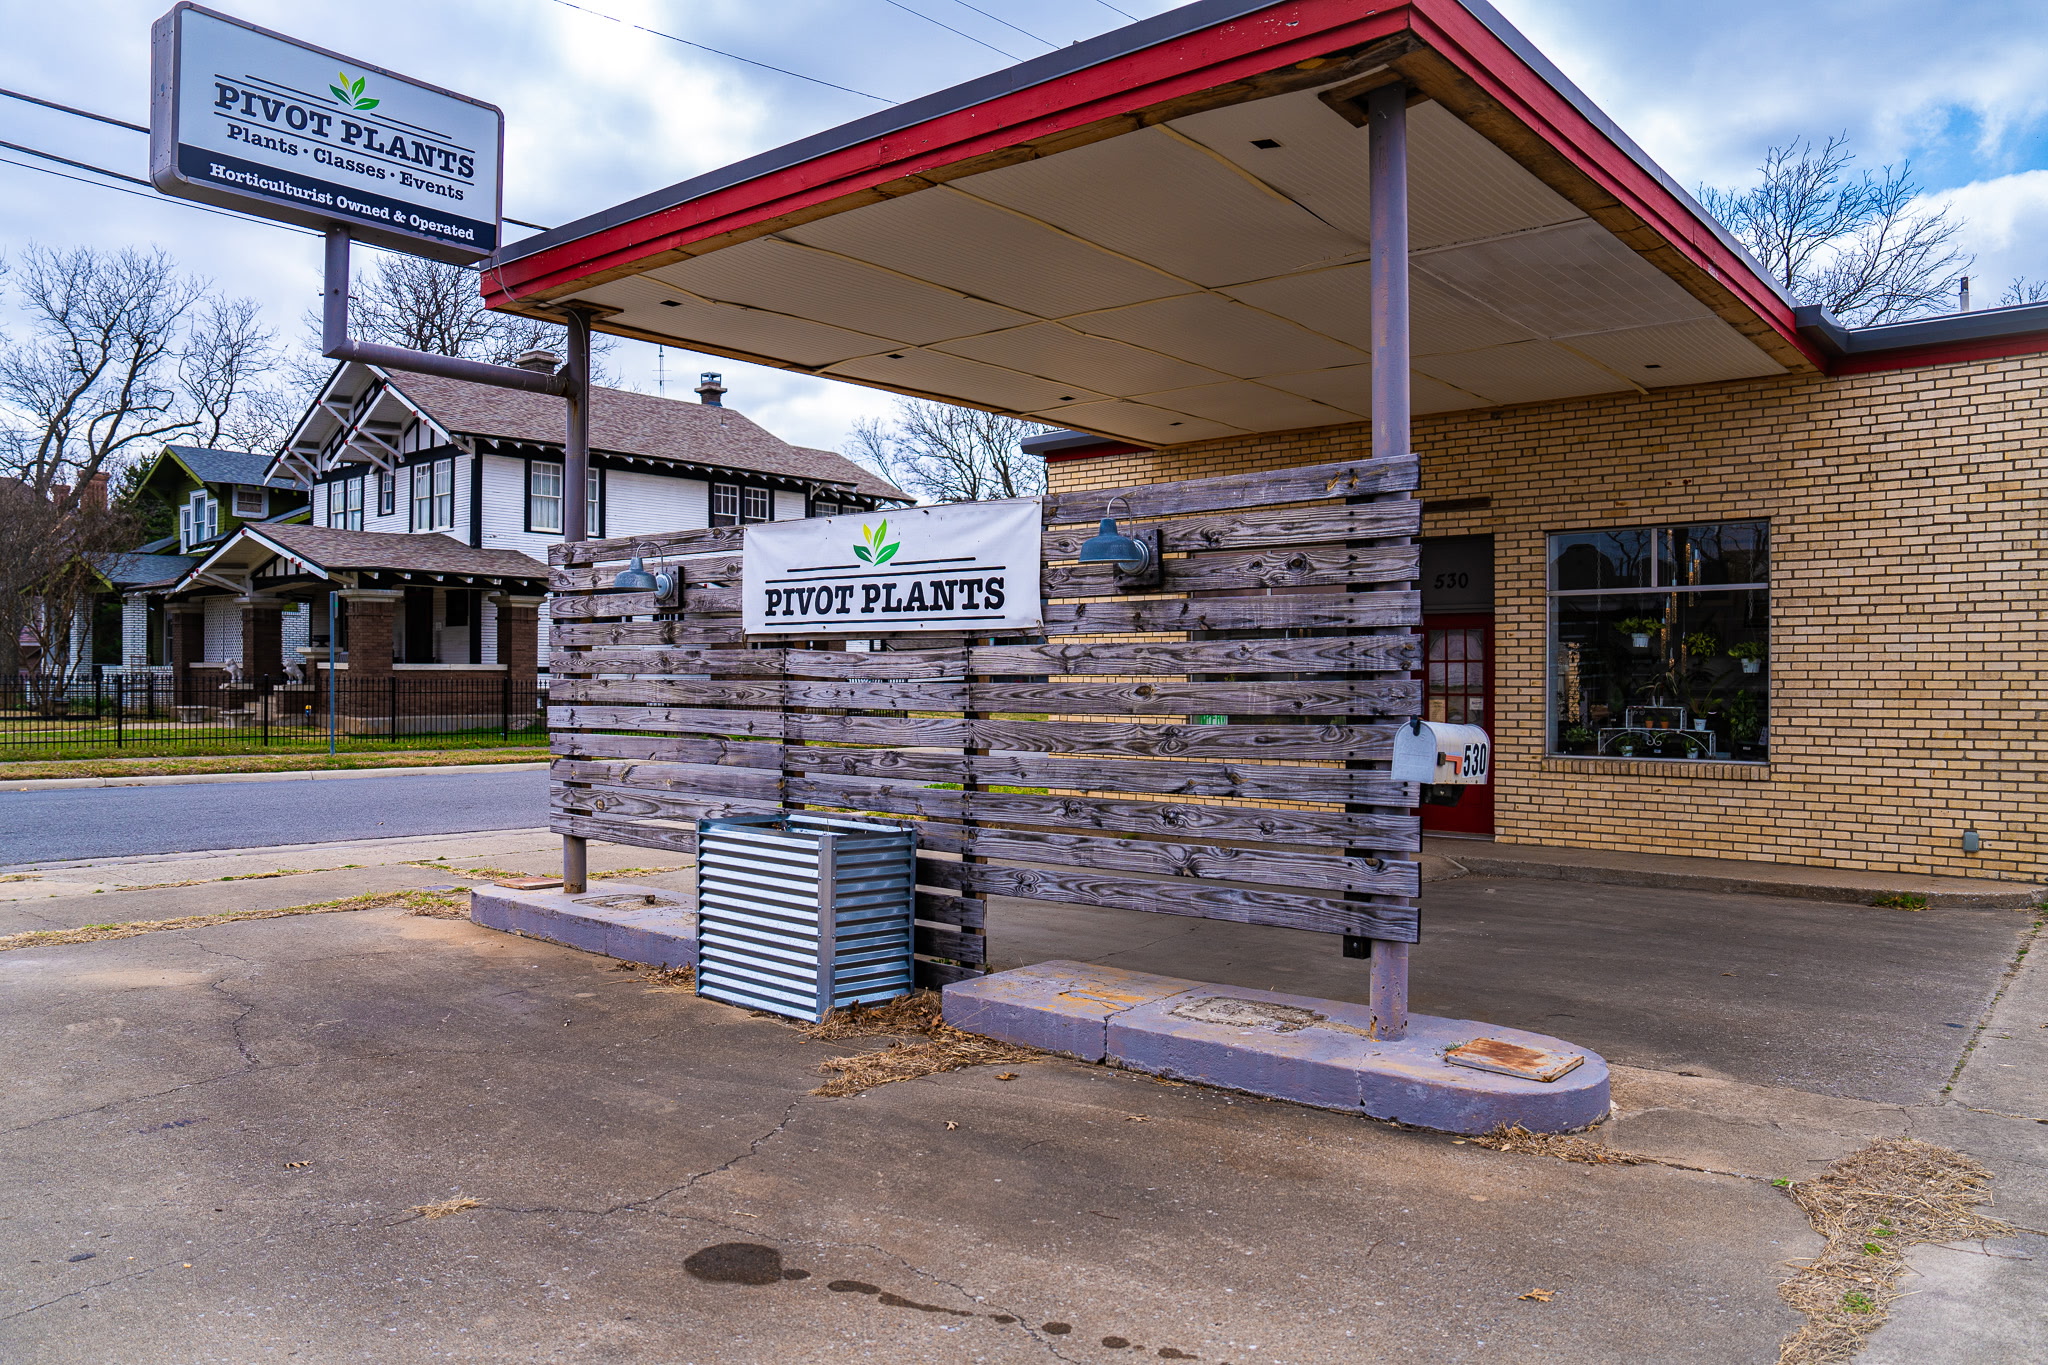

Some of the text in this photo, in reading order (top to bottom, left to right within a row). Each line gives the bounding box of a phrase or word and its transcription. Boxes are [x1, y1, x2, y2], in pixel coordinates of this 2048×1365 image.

[214, 82, 475, 179] PIVOT PLANTS
[227, 122, 464, 201] Plants Classes Events
[209, 162, 475, 241] Horticulturist Owned & Operated
[765, 576, 1005, 617] PIVOT PLANTS
[1434, 572, 1469, 590] 530
[1463, 743, 1487, 777] 530
